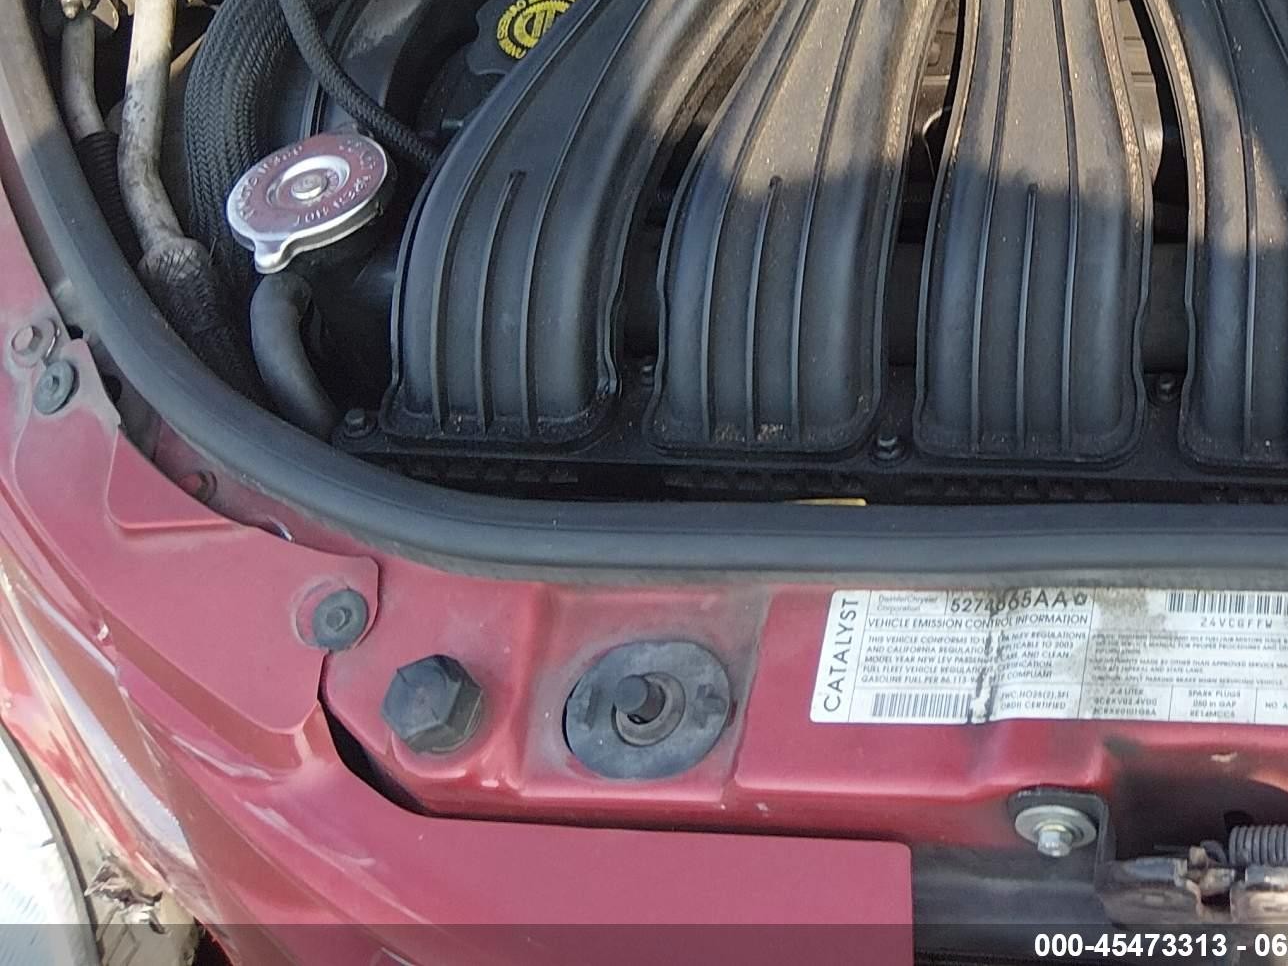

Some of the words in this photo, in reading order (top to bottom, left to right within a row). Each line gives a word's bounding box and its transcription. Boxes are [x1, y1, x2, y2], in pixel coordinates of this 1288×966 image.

[868, 618, 908, 628] VEHICLE
[912, 618, 963, 628] EMISSION
[964, 616, 1013, 628] CONTROL
[1015, 614, 1088, 626] INFORMATION
[823, 598, 859, 712] CATALYST
[887, 646, 936, 654] CALIFORNIA
